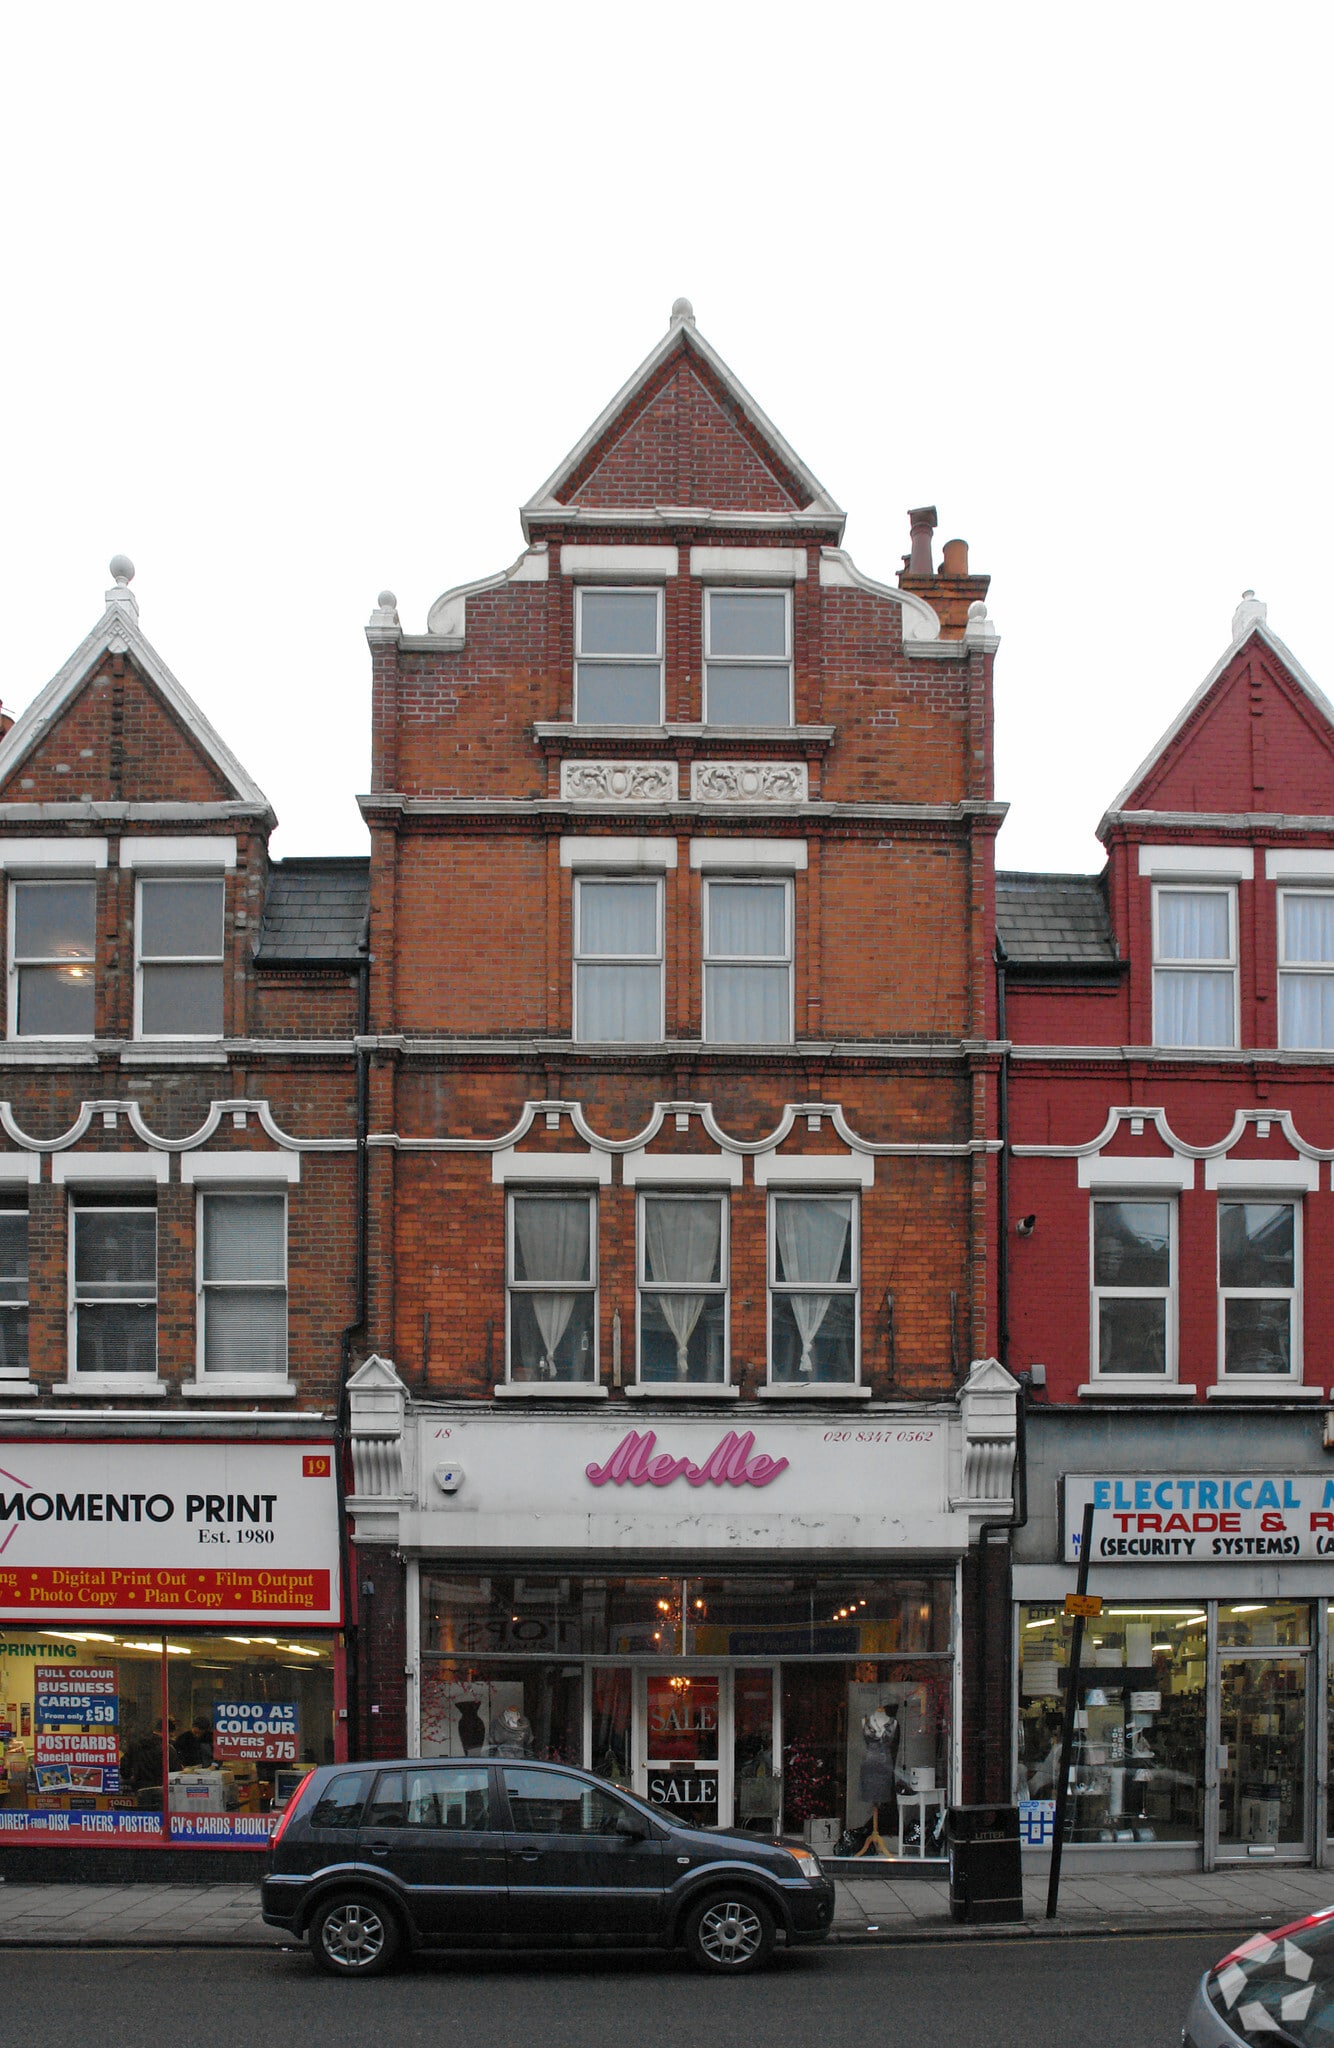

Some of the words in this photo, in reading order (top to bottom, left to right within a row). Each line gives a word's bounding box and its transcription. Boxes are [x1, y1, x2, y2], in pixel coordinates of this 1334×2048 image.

[434, 1428, 452, 1439] 18
[823, 1431, 852, 1442] 020
[855, 1431, 892, 1442] 8347
[896, 1431, 934, 1442] 0562
[307, 1459, 326, 1474] 19
[1094, 1480, 1301, 1510] ELECTRICAL
[186, 1494, 277, 1522] PRINT
[1113, 1513, 1241, 1533] TRADE
[1260, 1512, 1287, 1532] &
[198, 1529, 231, 1544] Est.
[236, 1528, 274, 1544] 1980
[1100, 1537, 1196, 1556] (SECURITY
[1212, 1536, 1300, 1555] SYSTEMS)
[52, 1570, 106, 1587] Digital
[111, 1571, 152, 1586] Print
[156, 1571, 187, 1586] Out
[216, 1572, 252, 1586] Film
[257, 1572, 314, 1589] Output
[29, 1587, 74, 1601] Photo
[77, 1588, 118, 1605] Copy
[144, 1588, 180, 1603] Plan
[184, 1589, 224, 1606] Copy
[251, 1590, 314, 1606] Binding
[0, 1643, 77, 1657] PRINTING
[37, 1669, 66, 1678] FULL
[69, 1670, 114, 1678] COLOUR
[37, 1682, 115, 1693] BUSINESS
[38, 1696, 91, 1708] CARDS
[66, 1712, 84, 1721] only
[86, 1706, 115, 1722] £59
[217, 1705, 263, 1718] 1000
[269, 1706, 294, 1719] A5
[650, 1706, 718, 1731] SALE
[216, 1720, 296, 1735] COLOUR
[37, 1735, 117, 1751] POSTCARDS
[216, 1736, 265, 1747] FLYERS
[36, 1751, 74, 1763] Special
[75, 1753, 105, 1763] Offers
[240, 1750, 263, 1758] ONLY
[265, 1741, 296, 1760] £75
[650, 1779, 718, 1803] SALE
[48, 1814, 70, 1831] DISK
[81, 1815, 117, 1835] FLYERS,
[119, 1816, 163, 1836] POSTERS,
[196, 1816, 233, 1836] CARDS,
[975, 1831, 1005, 1840] LITTER
